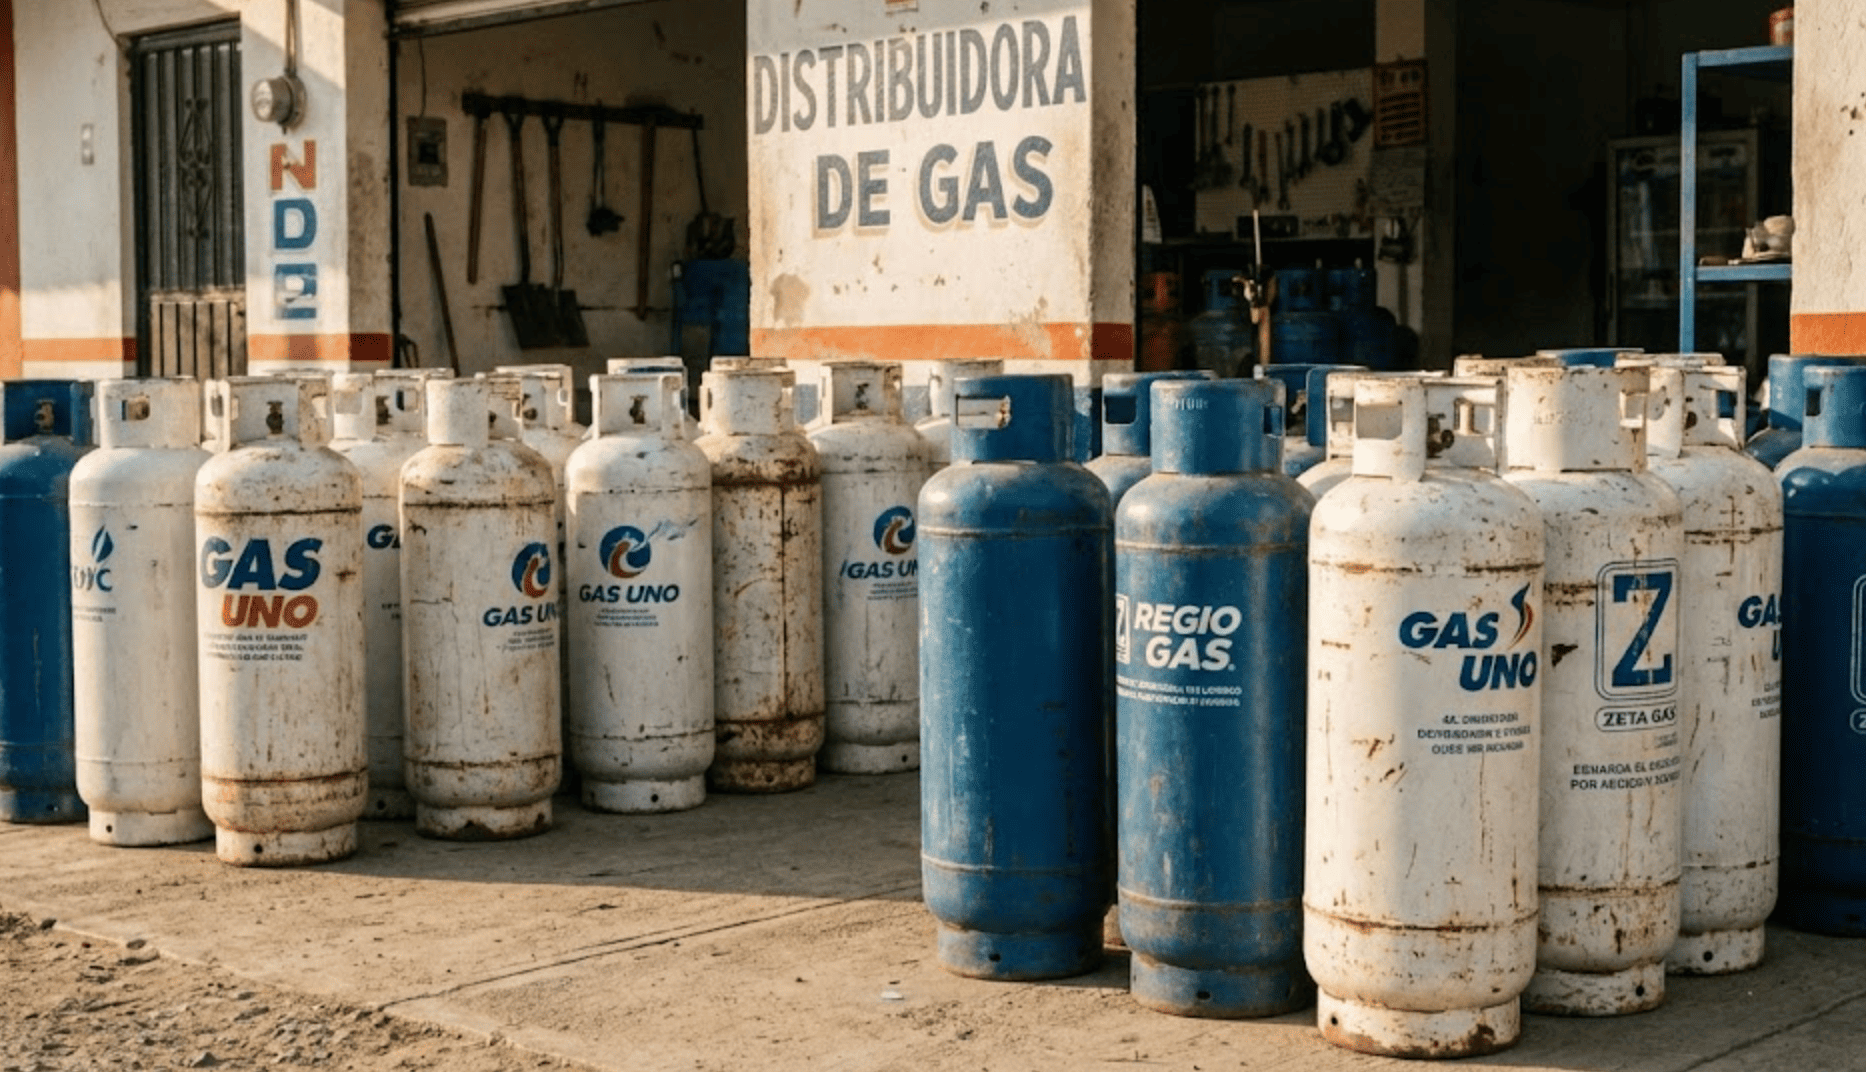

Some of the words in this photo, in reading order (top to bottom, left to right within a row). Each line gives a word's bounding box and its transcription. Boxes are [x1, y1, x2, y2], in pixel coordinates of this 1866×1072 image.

[753, 15, 1087, 135] DISTRIBUIDORA
[816, 149, 891, 229] DE
[918, 135, 1053, 224] GAS
[200, 536, 323, 591] GAS
[580, 584, 620, 603] GAS
[626, 584, 679, 603] UNO
[1738, 594, 1781, 629] GA
[222, 595, 319, 629] UNO
[483, 605, 533, 627] GAS
[1134, 601, 1242, 636] REGIO
[1399, 611, 1499, 649] GAS
[1612, 571, 1673, 687] Z
[1459, 651, 1537, 692] UNO
[1603, 710, 1649, 727] ZETA
